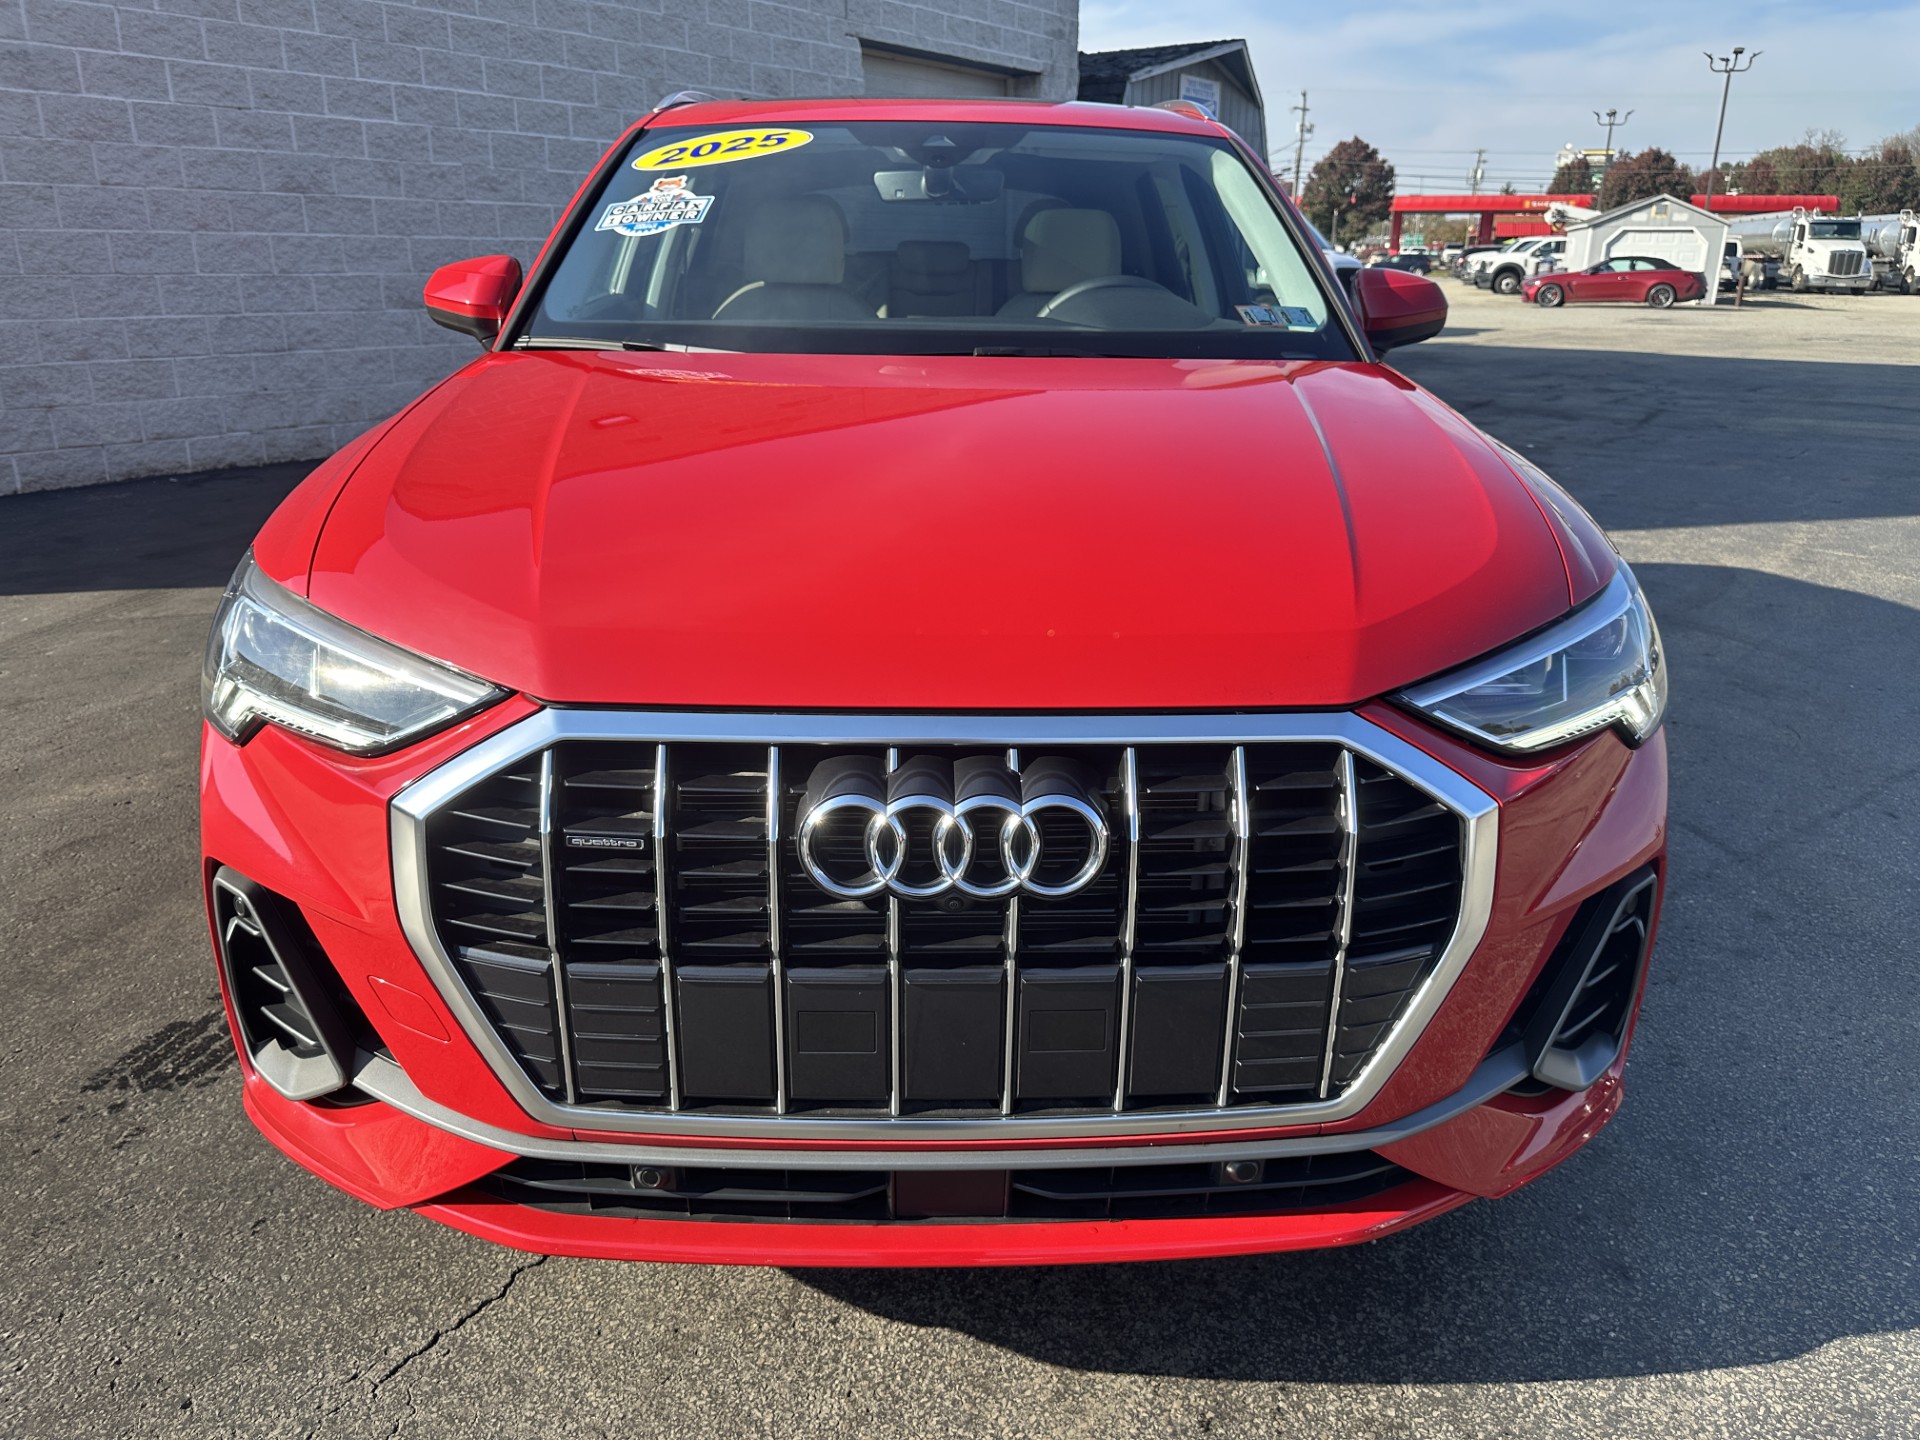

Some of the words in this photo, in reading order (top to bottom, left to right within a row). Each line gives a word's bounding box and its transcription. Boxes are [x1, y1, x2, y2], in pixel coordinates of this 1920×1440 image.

[653, 132, 791, 166] 2025
[611, 201, 704, 215] CARFAX
[571, 838, 637, 847] quattro
